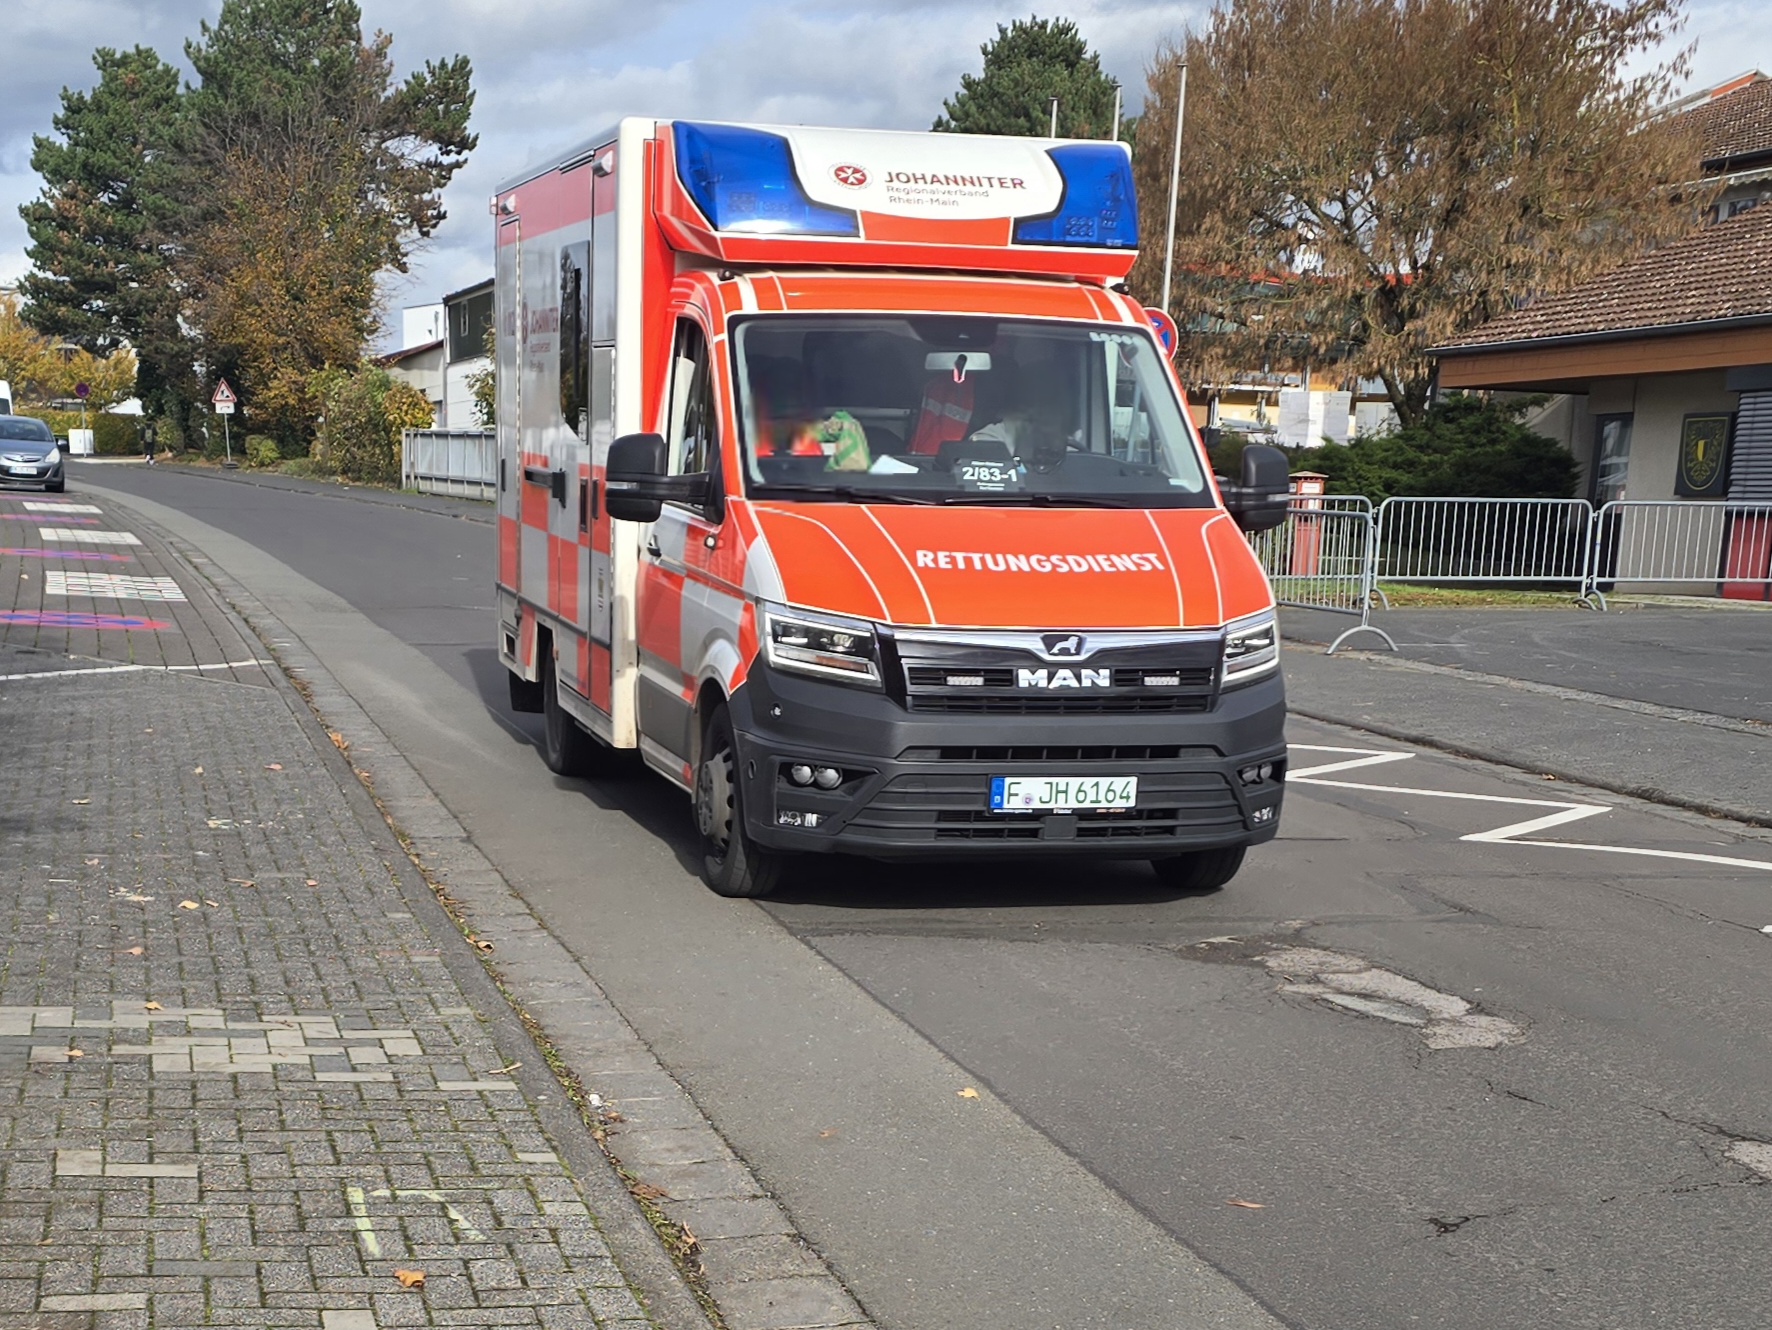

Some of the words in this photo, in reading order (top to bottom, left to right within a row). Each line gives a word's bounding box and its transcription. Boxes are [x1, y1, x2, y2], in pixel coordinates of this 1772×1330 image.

[884, 171, 1027, 190] JOHANNITER
[886, 185, 990, 198] Regionalverband
[889, 196, 959, 207] Rhein-Main
[915, 550, 1165, 573] RETTUNGSDIENST
[1017, 668, 1110, 689] MAN
[1007, 781, 1021, 805] F
[1039, 781, 1069, 805] JH
[1075, 781, 1131, 804] 6164
